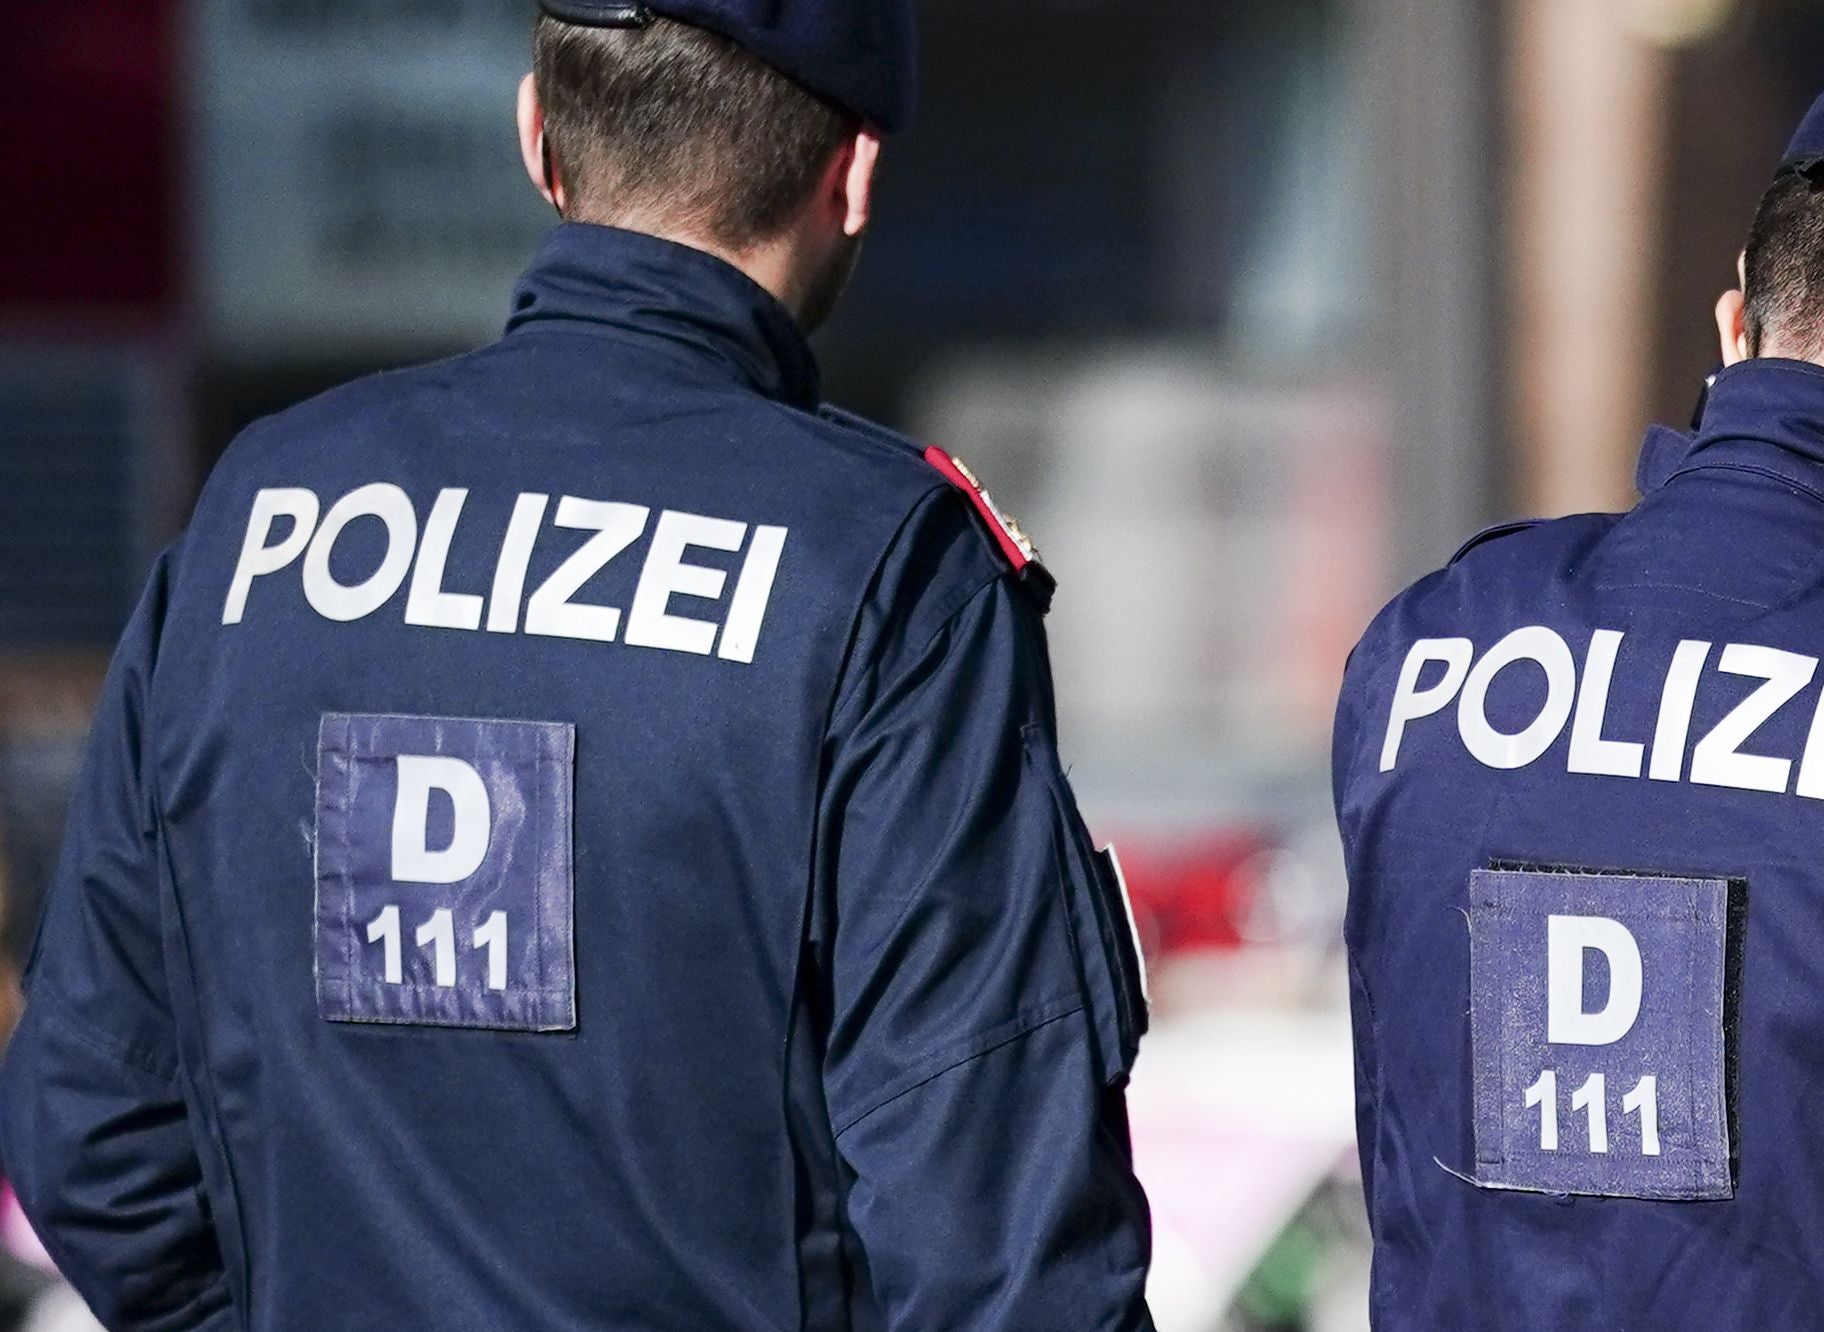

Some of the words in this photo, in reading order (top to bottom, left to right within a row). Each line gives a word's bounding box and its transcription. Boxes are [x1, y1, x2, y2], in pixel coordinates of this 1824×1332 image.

[223, 483, 787, 663] POLIZEI
[391, 755, 490, 883] D
[367, 906, 507, 990] 111
[1547, 914, 1643, 1046] D
[1522, 1070, 1660, 1155] 111
